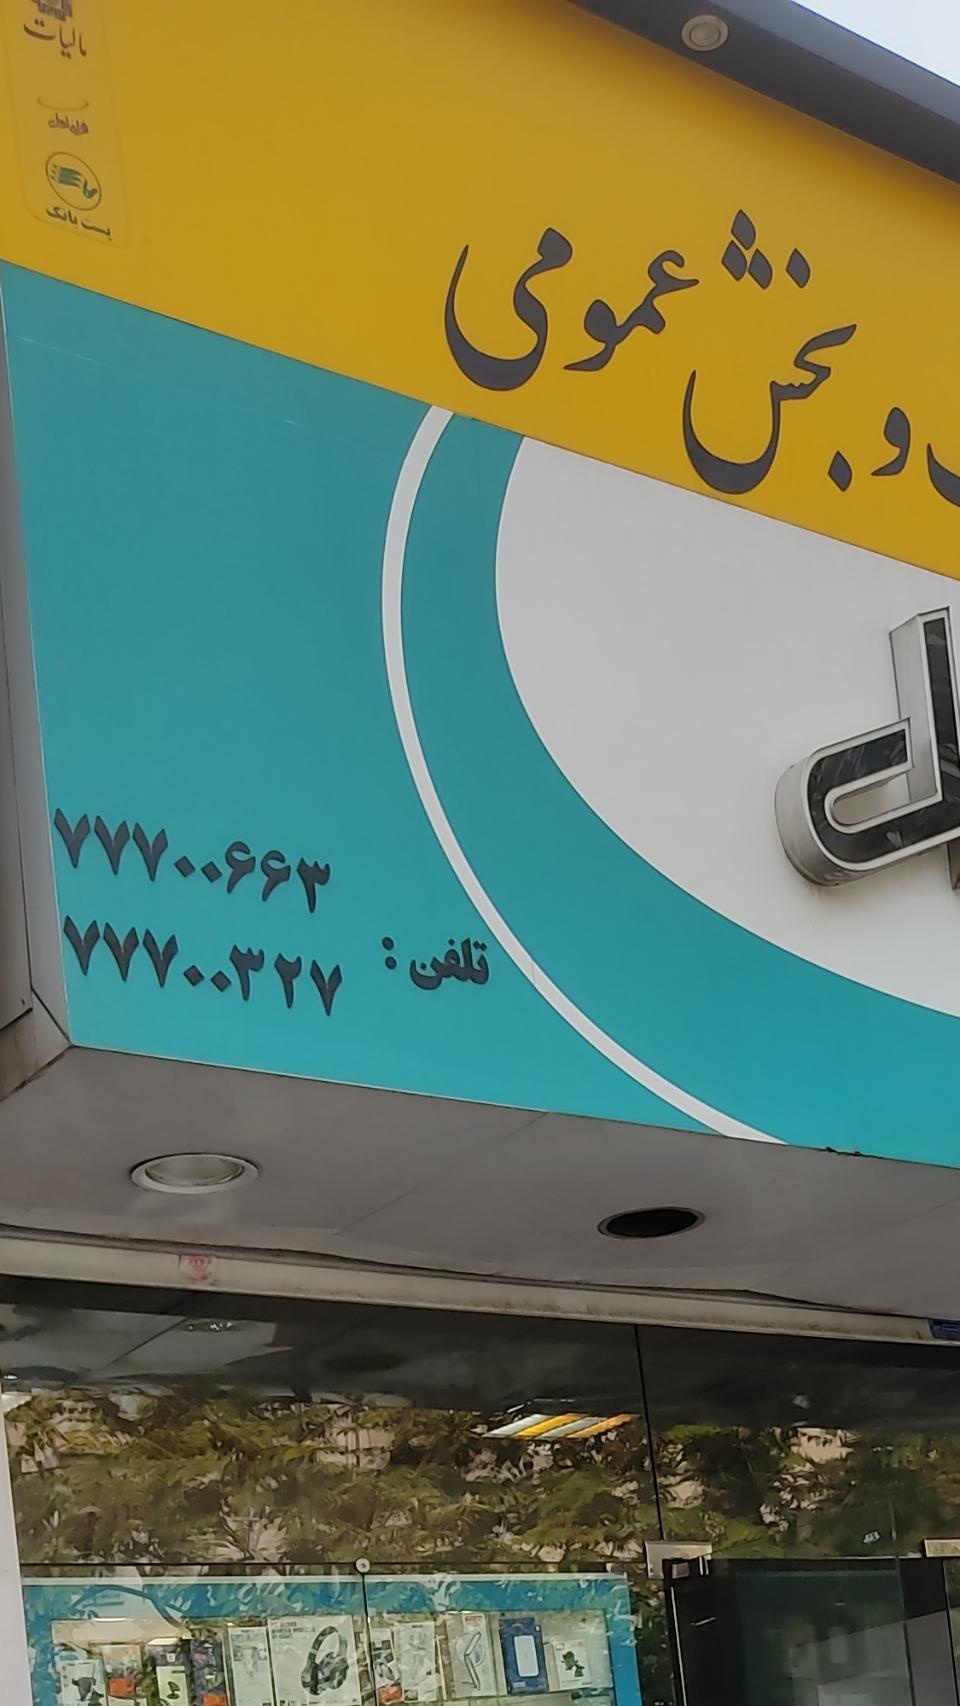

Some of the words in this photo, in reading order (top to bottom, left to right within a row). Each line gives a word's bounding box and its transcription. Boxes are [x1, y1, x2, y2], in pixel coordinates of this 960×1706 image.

[24, 18, 88, 59] مالیات
[46, 206, 78, 229] بانک
[81, 218, 113, 241] پست
[443, 227, 700, 392] عمومی
[682, 209, 858, 495] بخش
[870, 408, 912, 478] و
[53, 807, 332, 914] ۷۷۷۰۰۶۶۳
[63, 915, 343, 1017] ۷۷۷۰۰۳۲۷
